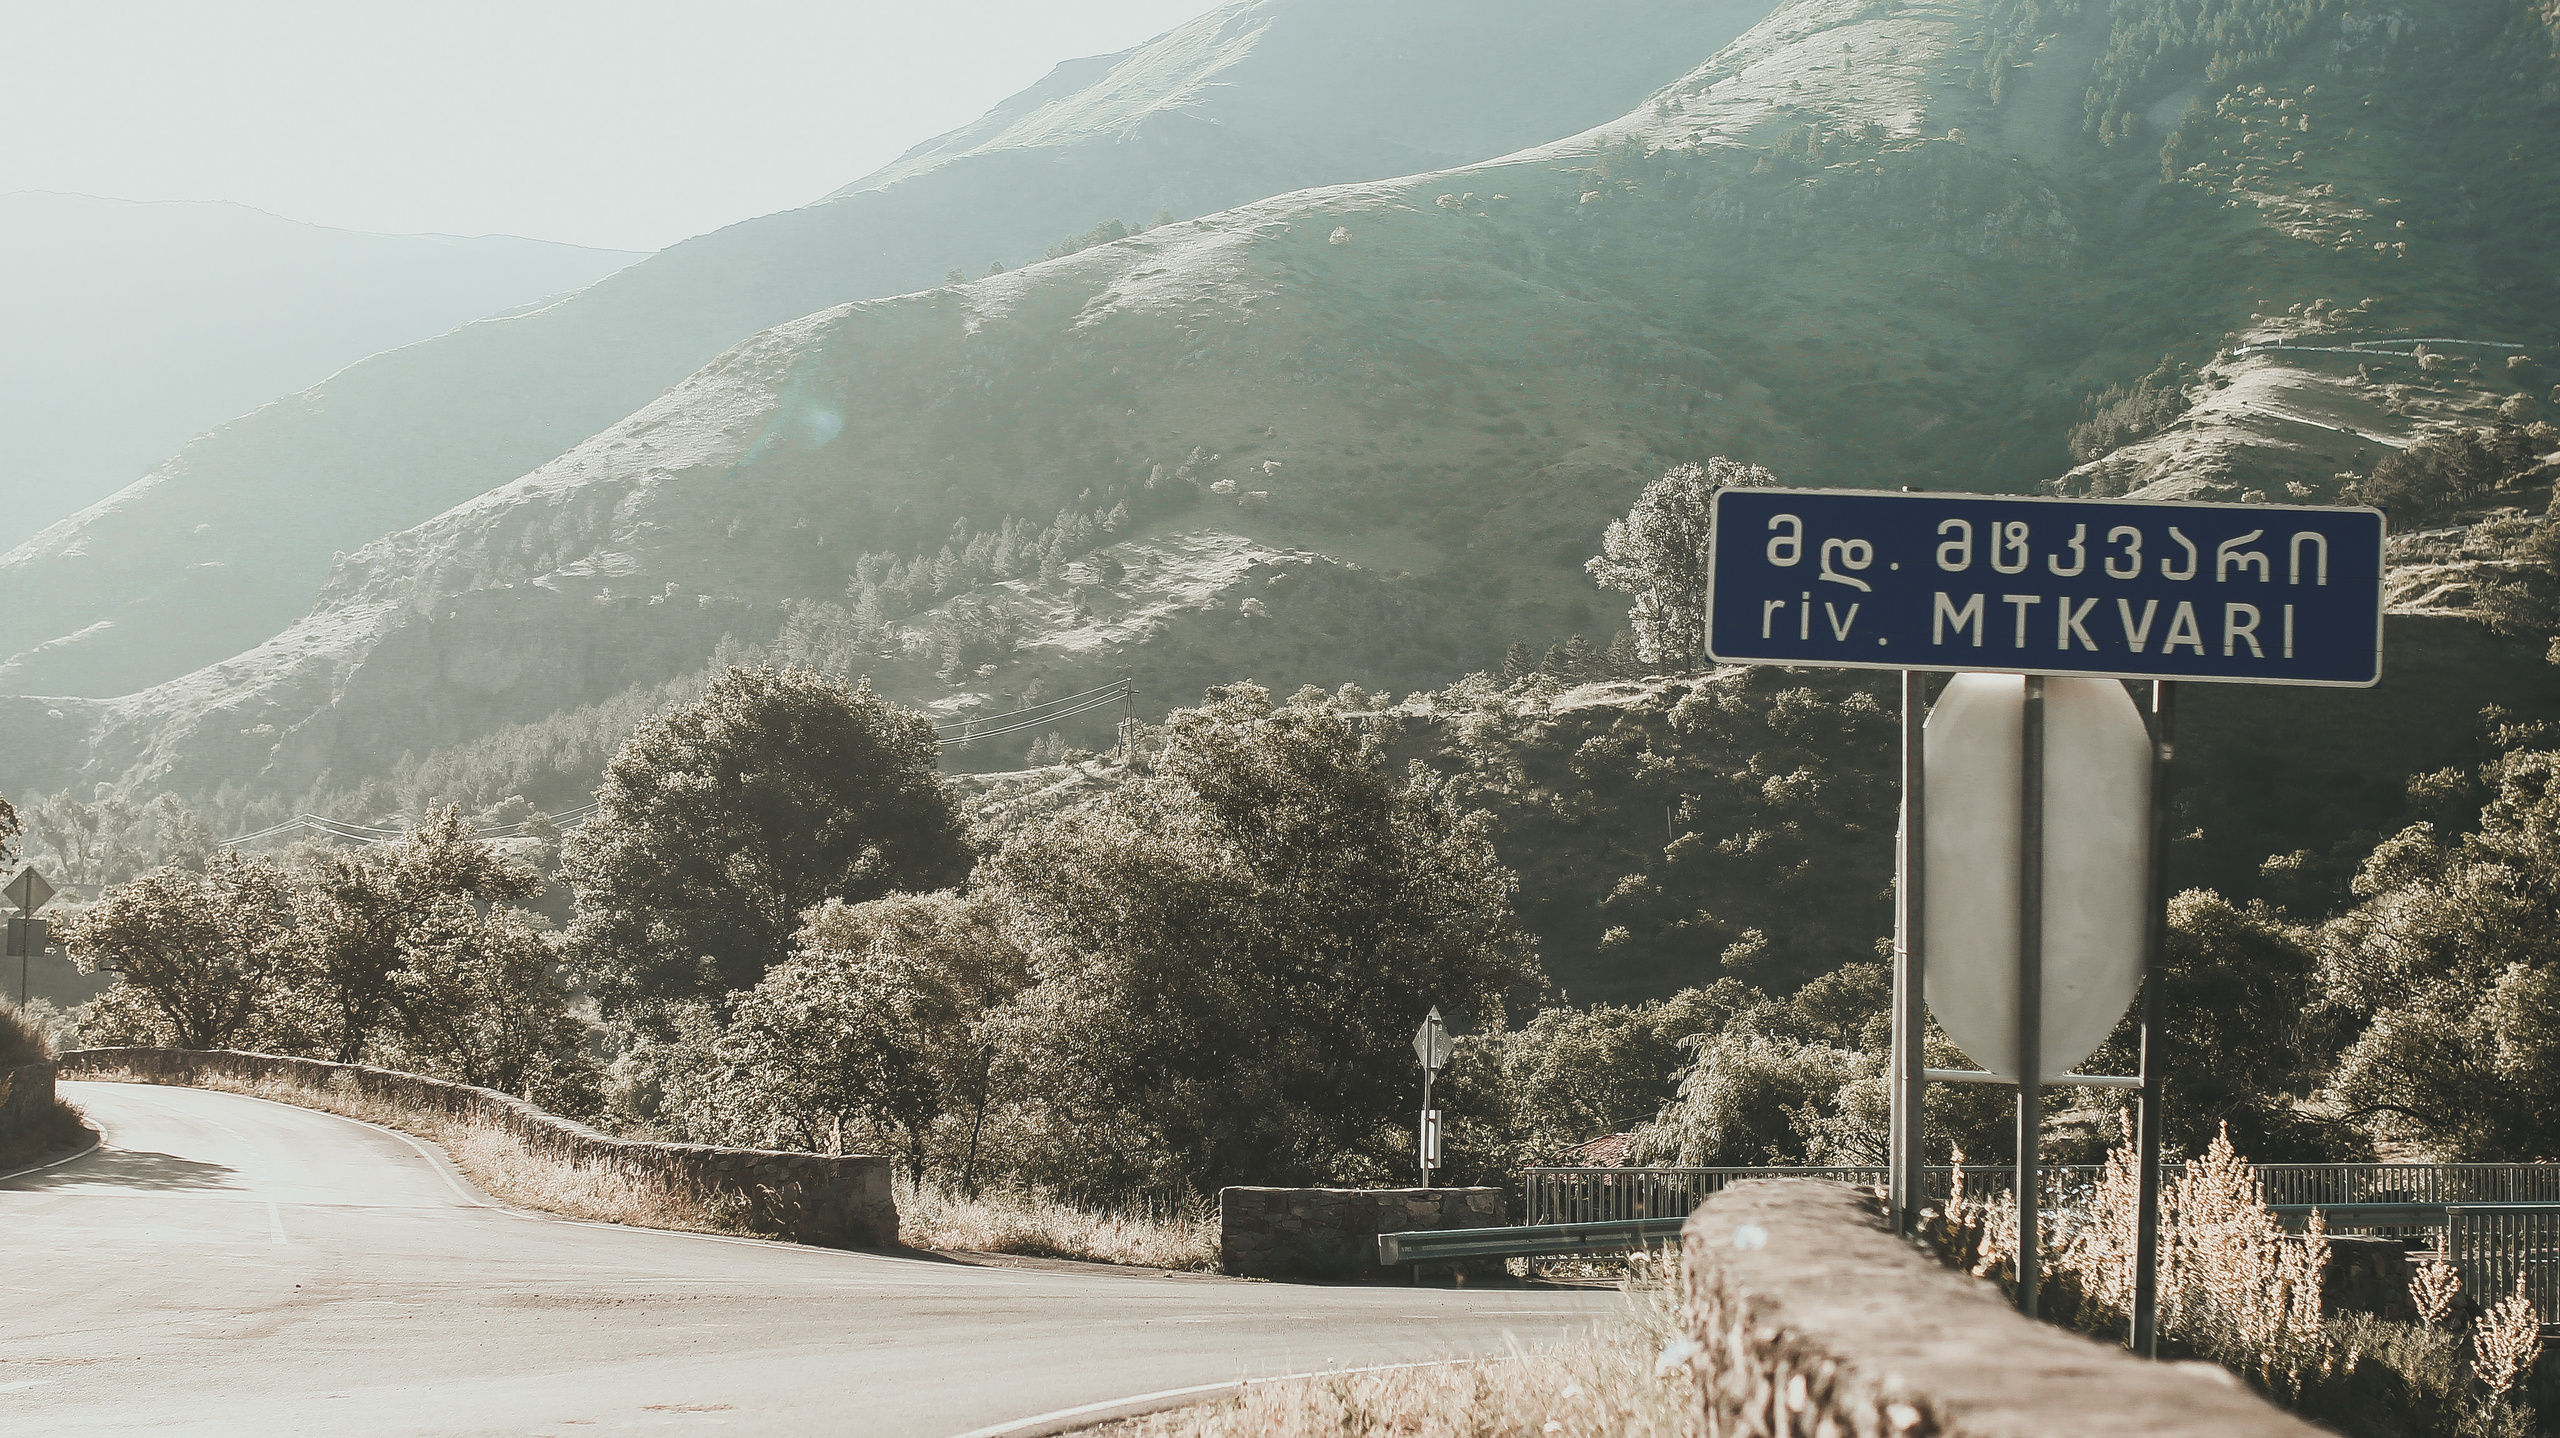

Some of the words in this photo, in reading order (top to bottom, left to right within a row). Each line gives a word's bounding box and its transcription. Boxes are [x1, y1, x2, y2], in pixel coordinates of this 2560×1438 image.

[1766, 513, 1900, 593] მდ.
[1936, 518, 2328, 586] მტკვარი
[1762, 591, 1888, 647] riv.
[1932, 591, 2294, 659] MTKVARI
